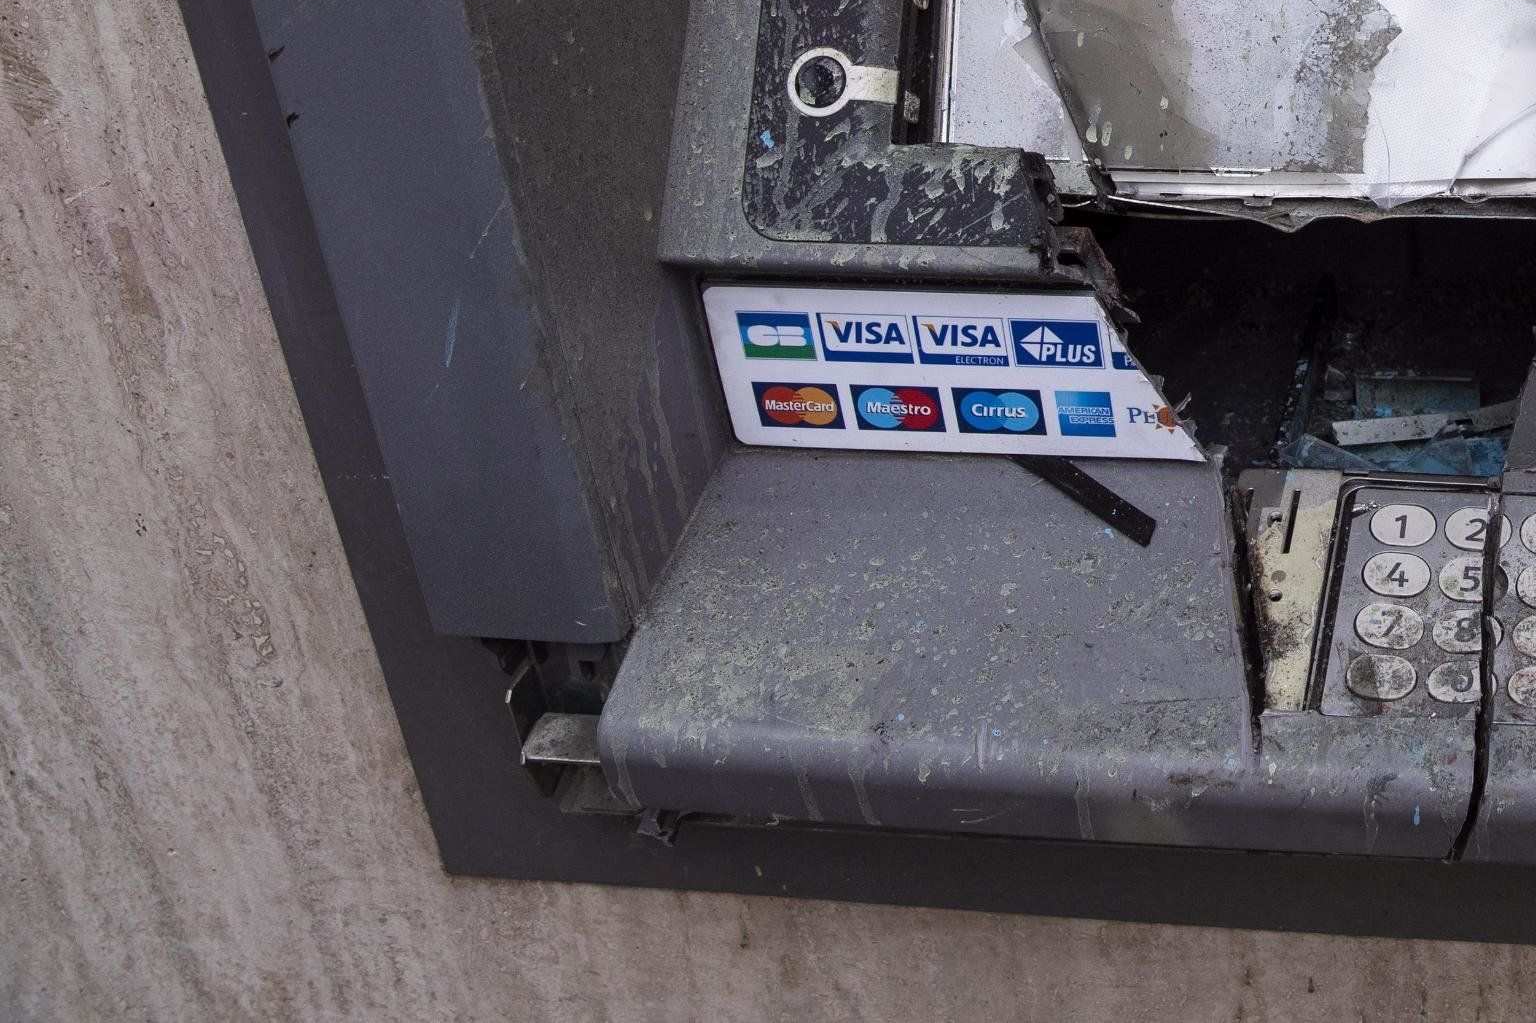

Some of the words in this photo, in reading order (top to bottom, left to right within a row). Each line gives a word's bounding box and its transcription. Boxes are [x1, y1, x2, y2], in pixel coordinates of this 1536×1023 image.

[824, 321, 905, 345] VISA
[920, 323, 1001, 348] VISA
[955, 355, 1004, 365] ELECTRON
[1041, 344, 1096, 363] PLUS
[764, 399, 835, 412] MasterCard
[866, 401, 932, 416] Maestro
[971, 403, 1026, 418] Cirrus
[1057, 406, 1110, 415] AMERICAN
[1070, 415, 1115, 424] EXPRESS
[1394, 514, 1408, 539] 1
[1464, 518, 1487, 542] 2
[1386, 562, 1409, 588] 4
[1459, 566, 1482, 593] 5
[1381, 609, 1403, 637] 7
[1453, 617, 1477, 643] 8
